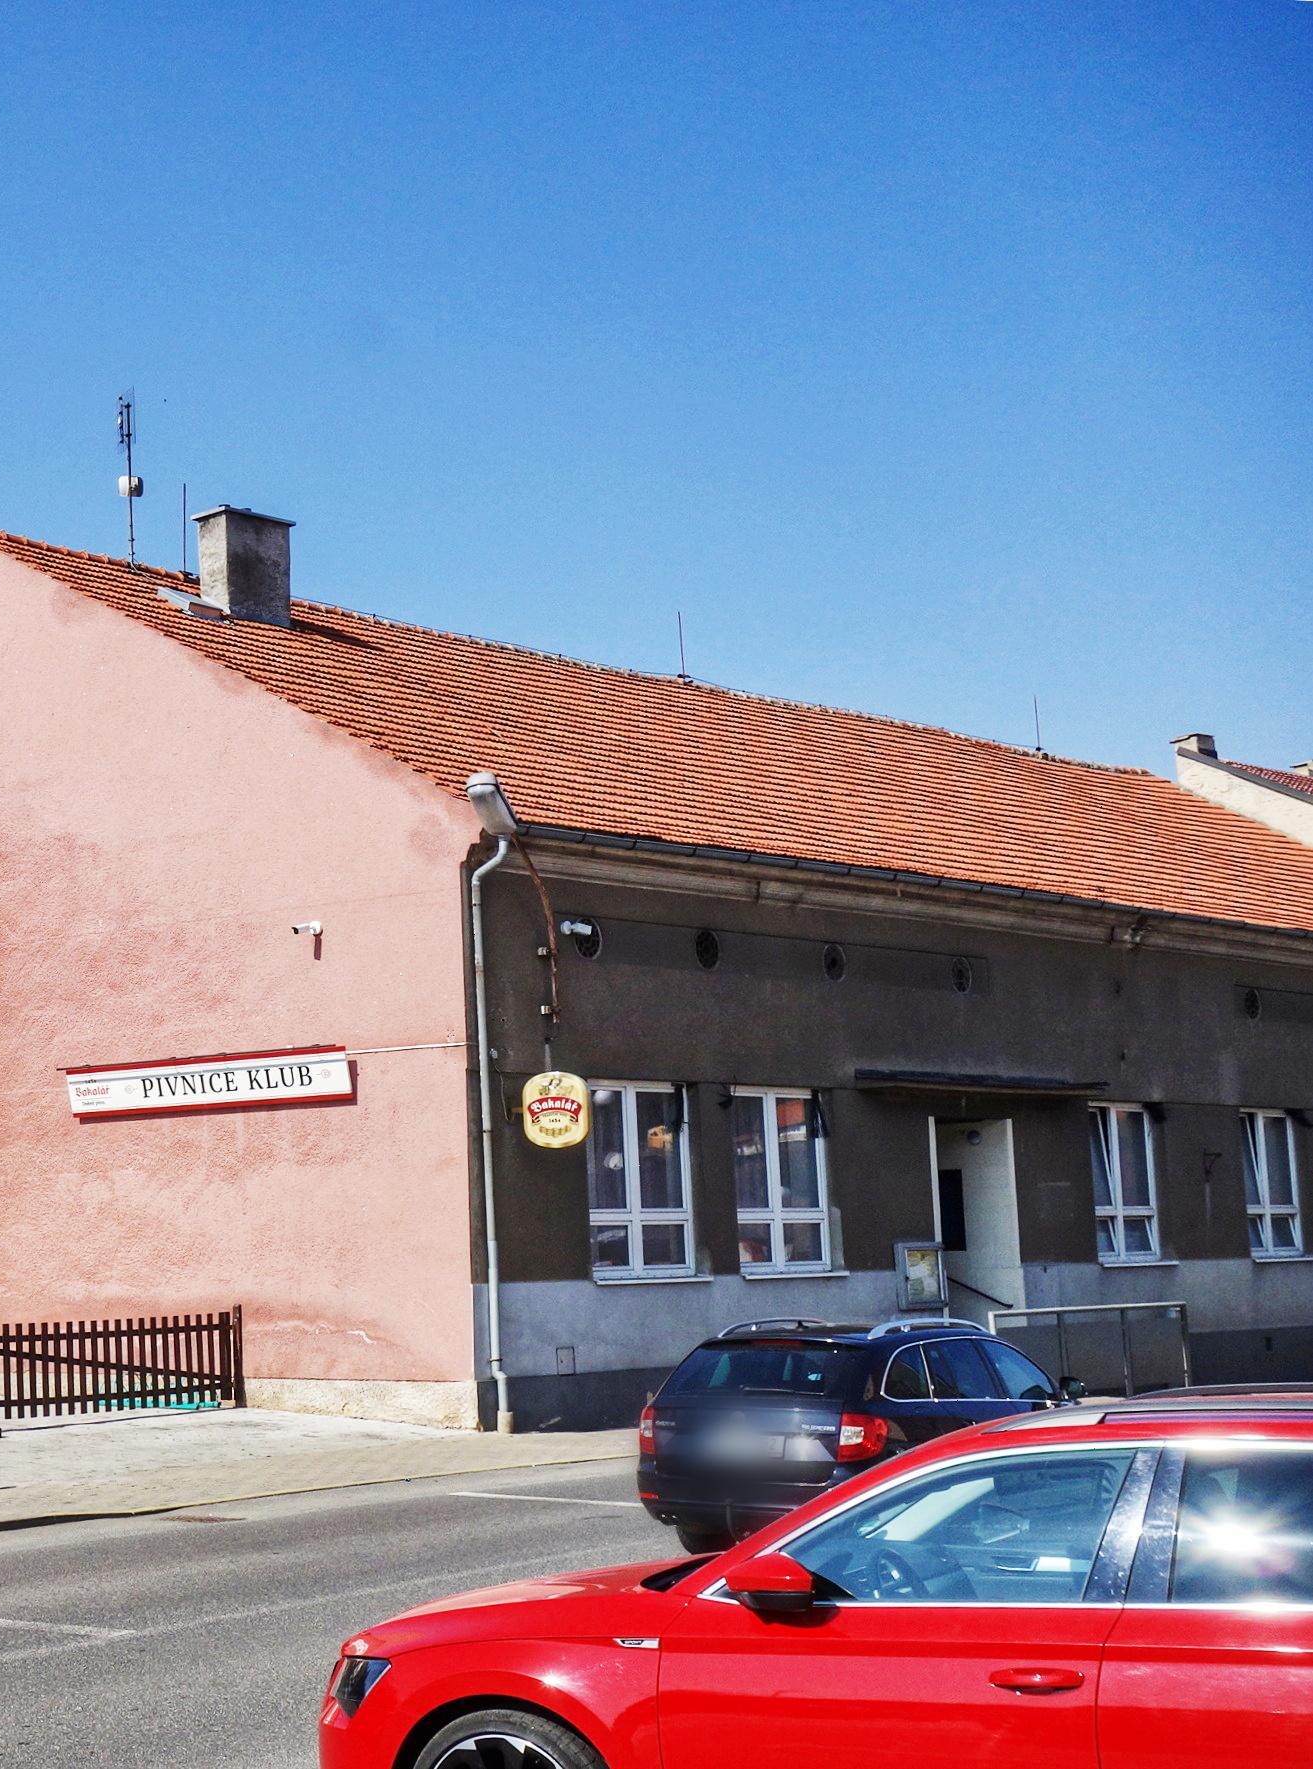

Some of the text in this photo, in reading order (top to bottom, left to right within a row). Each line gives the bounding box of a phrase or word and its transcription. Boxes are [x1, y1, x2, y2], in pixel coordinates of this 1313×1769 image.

[141, 1065, 314, 1099] PIVNICE KLUB
[530, 1099, 578, 1113] Bakalář
